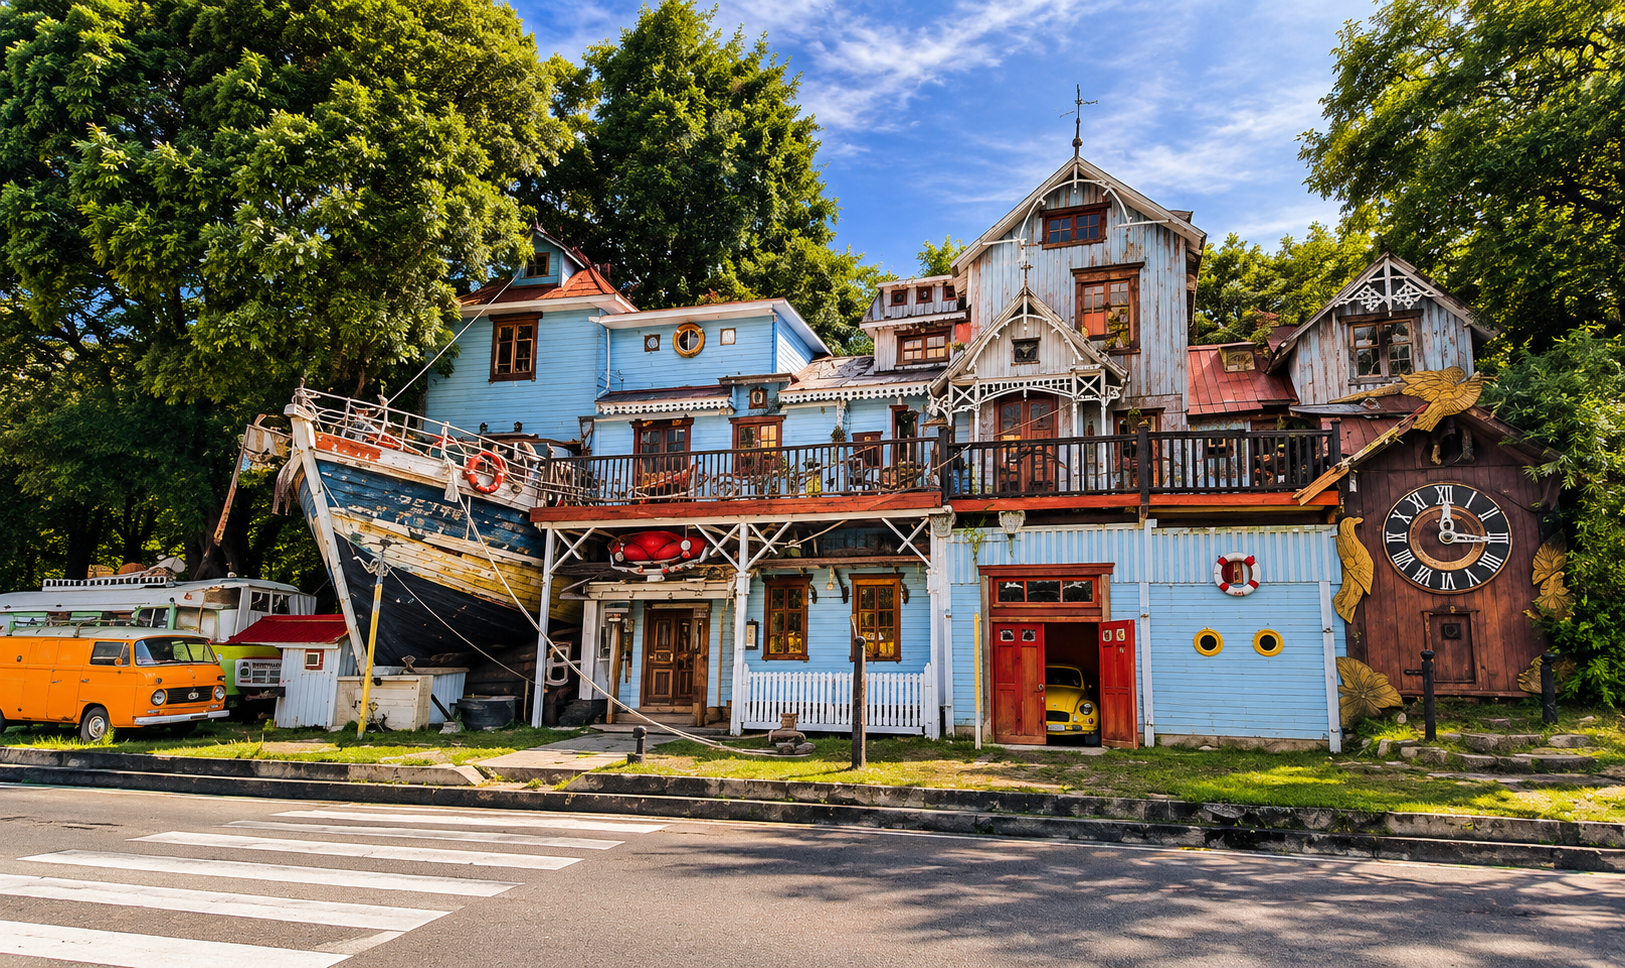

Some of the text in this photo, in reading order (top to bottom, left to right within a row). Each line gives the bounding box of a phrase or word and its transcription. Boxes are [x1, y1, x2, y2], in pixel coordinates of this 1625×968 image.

[1405, 491, 1429, 514] XI
[1434, 485, 1454, 505] XII
[1390, 509, 1413, 525] X
[1478, 506, 1500, 522] II
[1386, 531, 1407, 544] IX
[1487, 531, 1509, 544] III
[1391, 548, 1415, 571] VIII
[1440, 572, 1456, 590] VI
[1464, 568, 1481, 587] V
